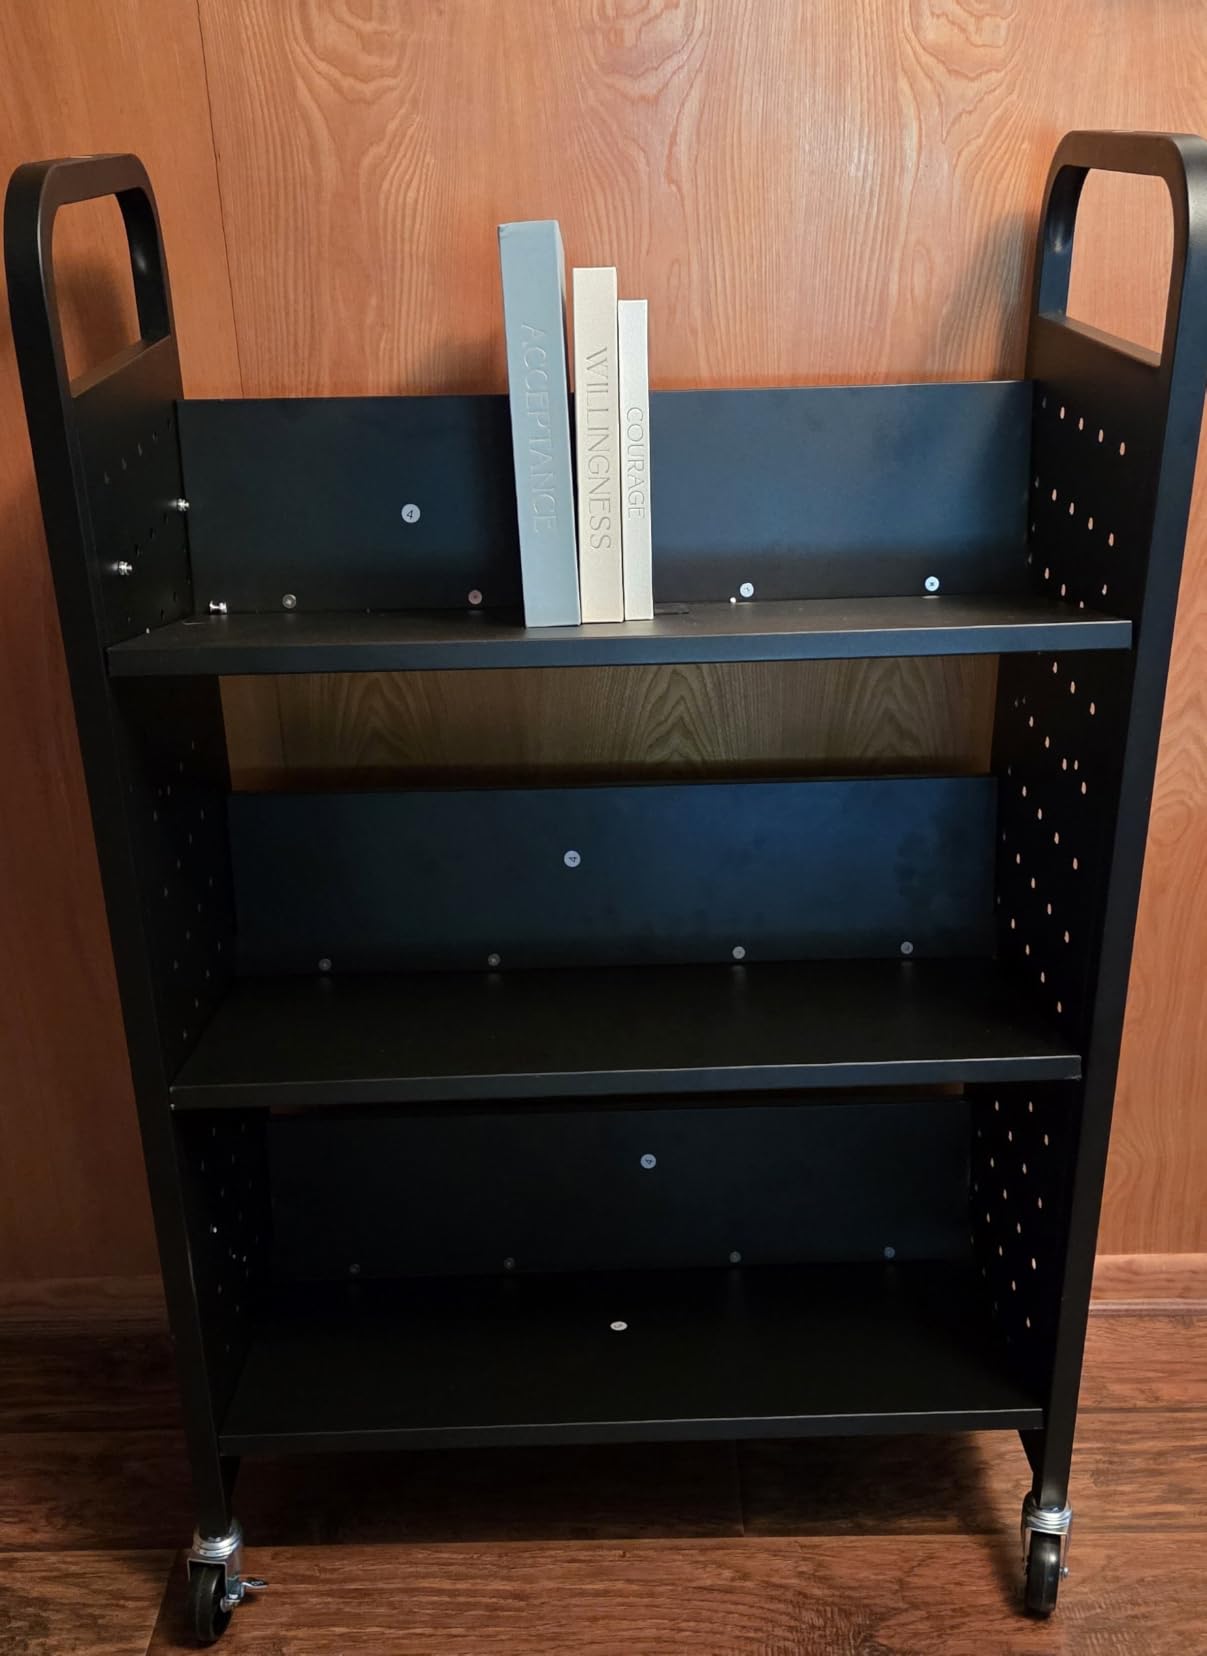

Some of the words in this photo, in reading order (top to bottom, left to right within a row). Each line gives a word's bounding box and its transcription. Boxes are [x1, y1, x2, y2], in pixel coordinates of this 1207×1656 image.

[521, 323, 557, 533] ACCEPTANCE
[586, 347, 611, 550] WILLINGNESS
[626, 406, 645, 519] COURAGE
